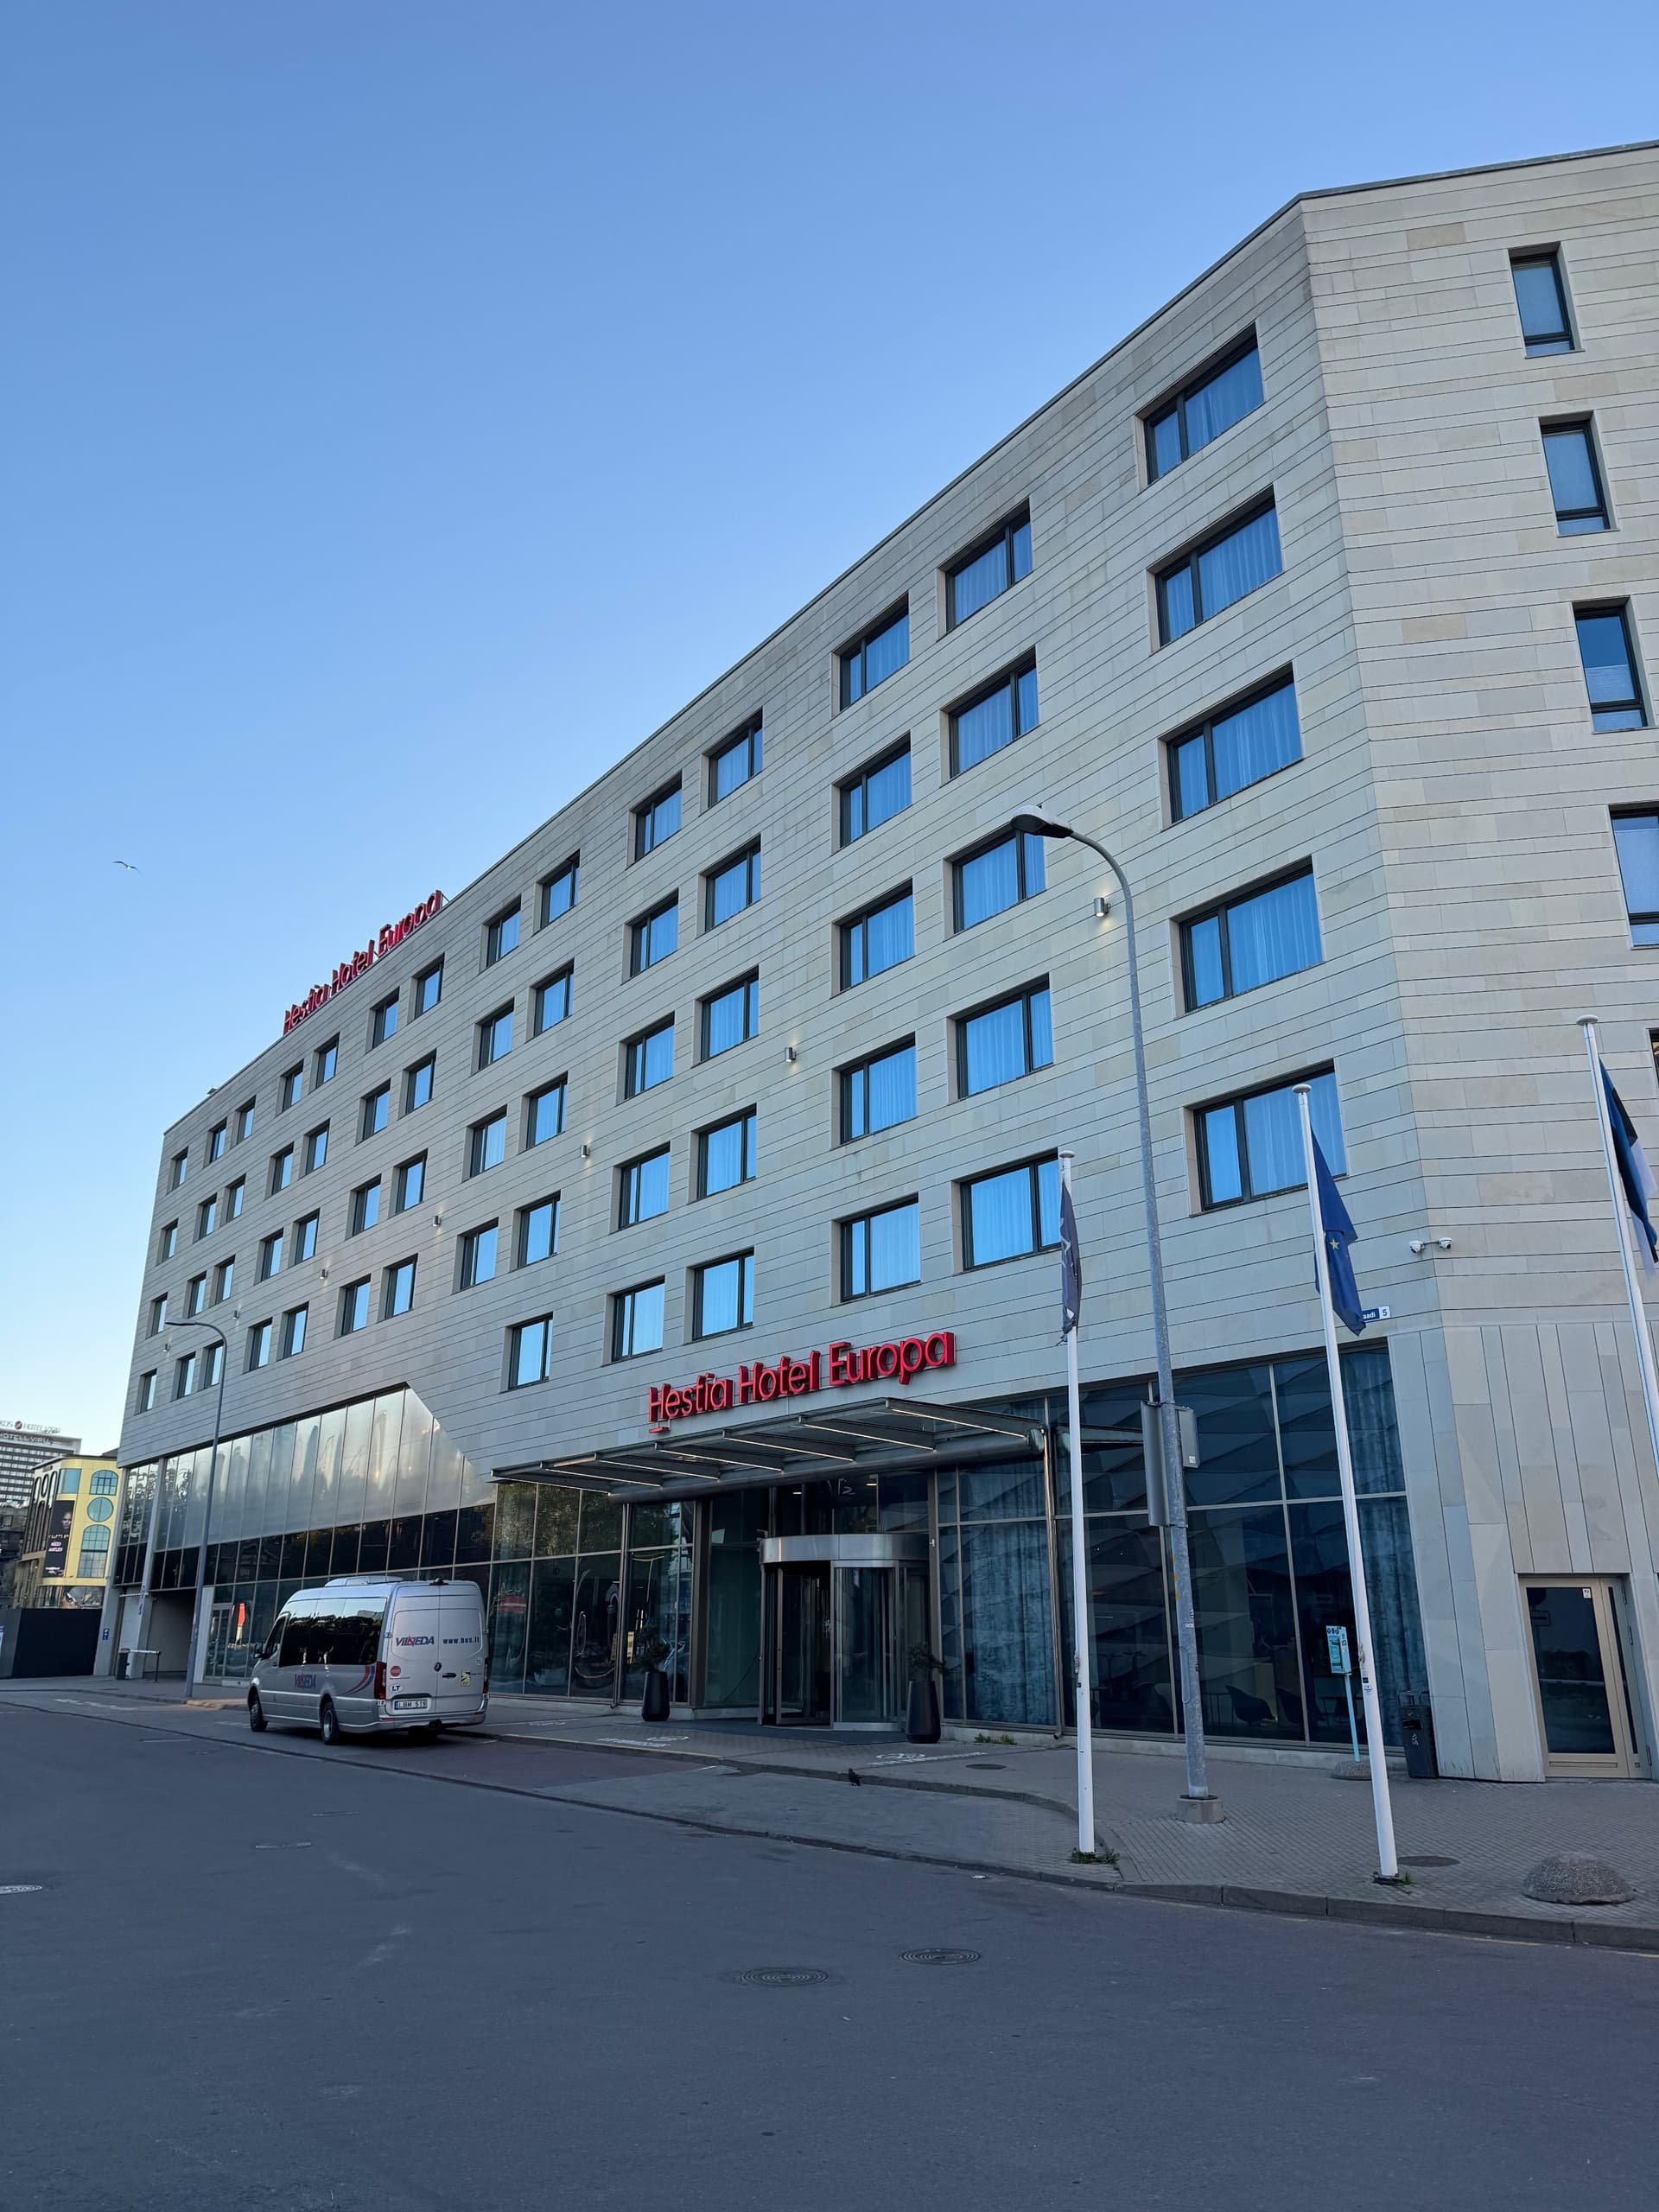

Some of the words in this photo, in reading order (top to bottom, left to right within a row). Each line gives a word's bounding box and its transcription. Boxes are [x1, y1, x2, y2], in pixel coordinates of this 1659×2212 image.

[283, 984, 330, 1035] Hestia
[332, 939, 375, 994] Hotel
[378, 890, 442, 957] Europa
[1363, 1311, 1376, 1319] aadi
[649, 1372, 734, 1422] Hestia
[739, 1350, 821, 1403] Hotel
[829, 1332, 956, 1385] Europa
